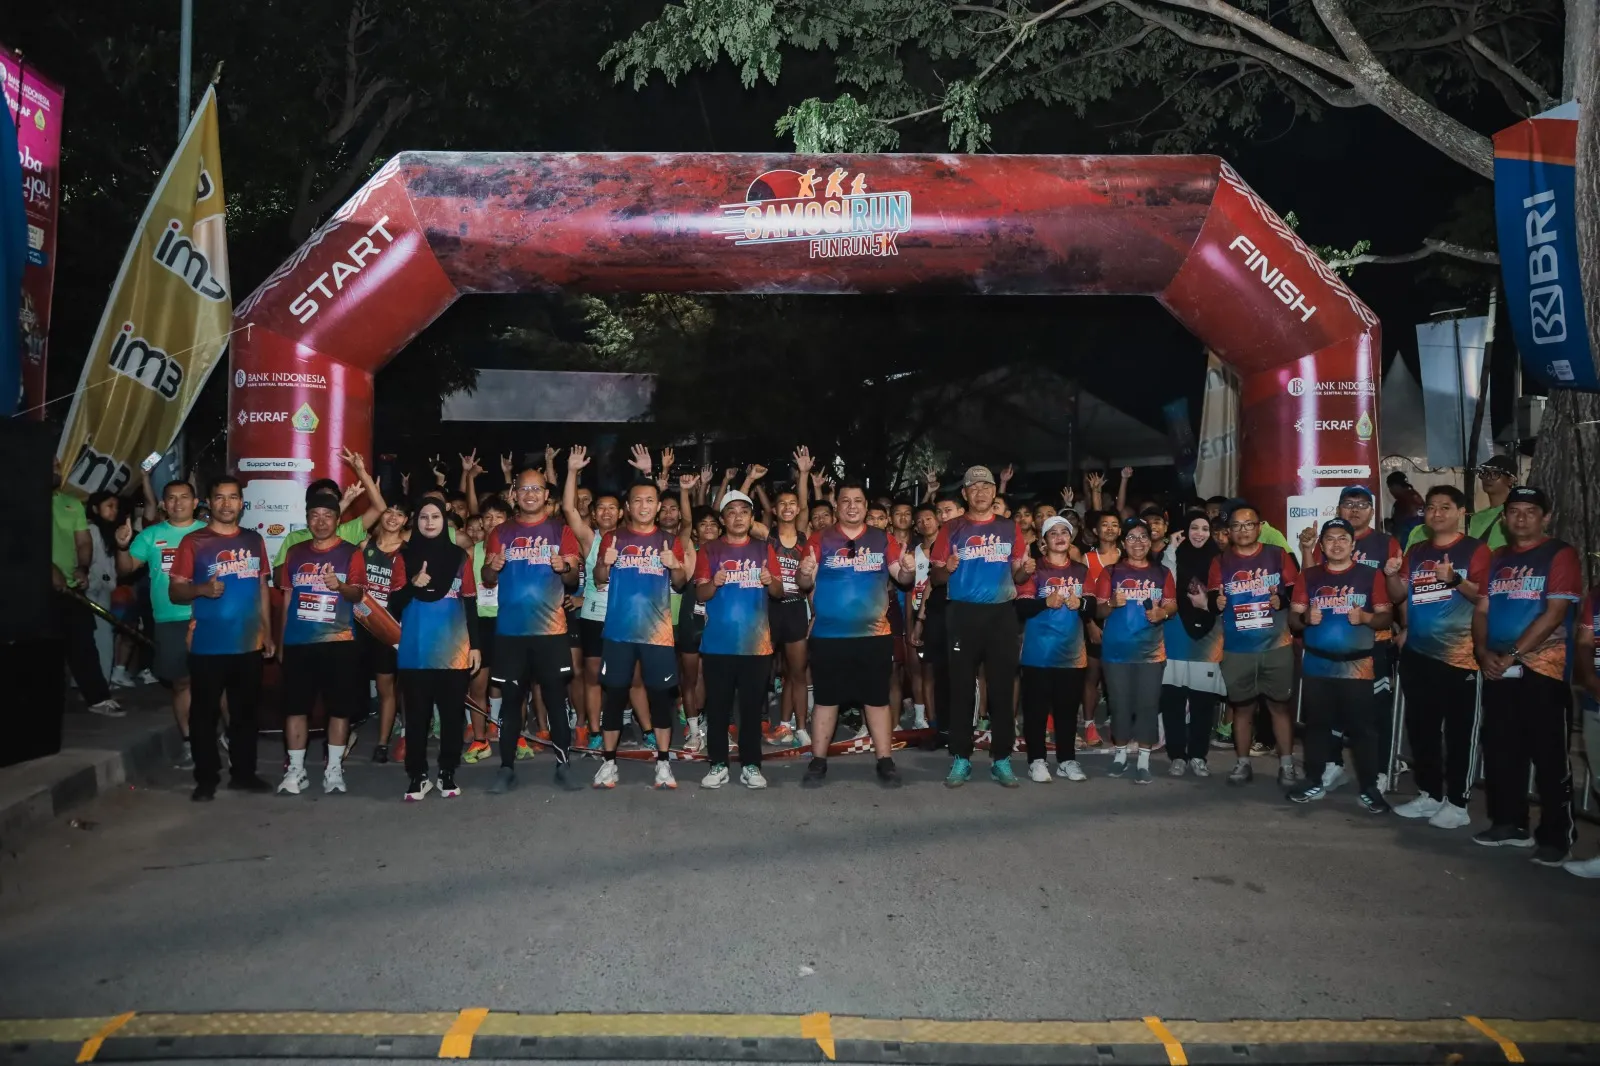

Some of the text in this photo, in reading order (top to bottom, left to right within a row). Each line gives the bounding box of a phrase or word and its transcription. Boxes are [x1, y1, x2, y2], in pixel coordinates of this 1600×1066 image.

[1523, 189, 1559, 285] BRI
[289, 215, 394, 324] START
[1228, 235, 1317, 323] FINISH
[109, 322, 183, 400] im3
[248, 372, 326, 384] BANK INDONESIA
[1314, 381, 1335, 390] ANK
[250, 412, 288, 422] EKRAF
[1315, 420, 1353, 430] EKRAF
[1300, 508, 1318, 517] BRI
